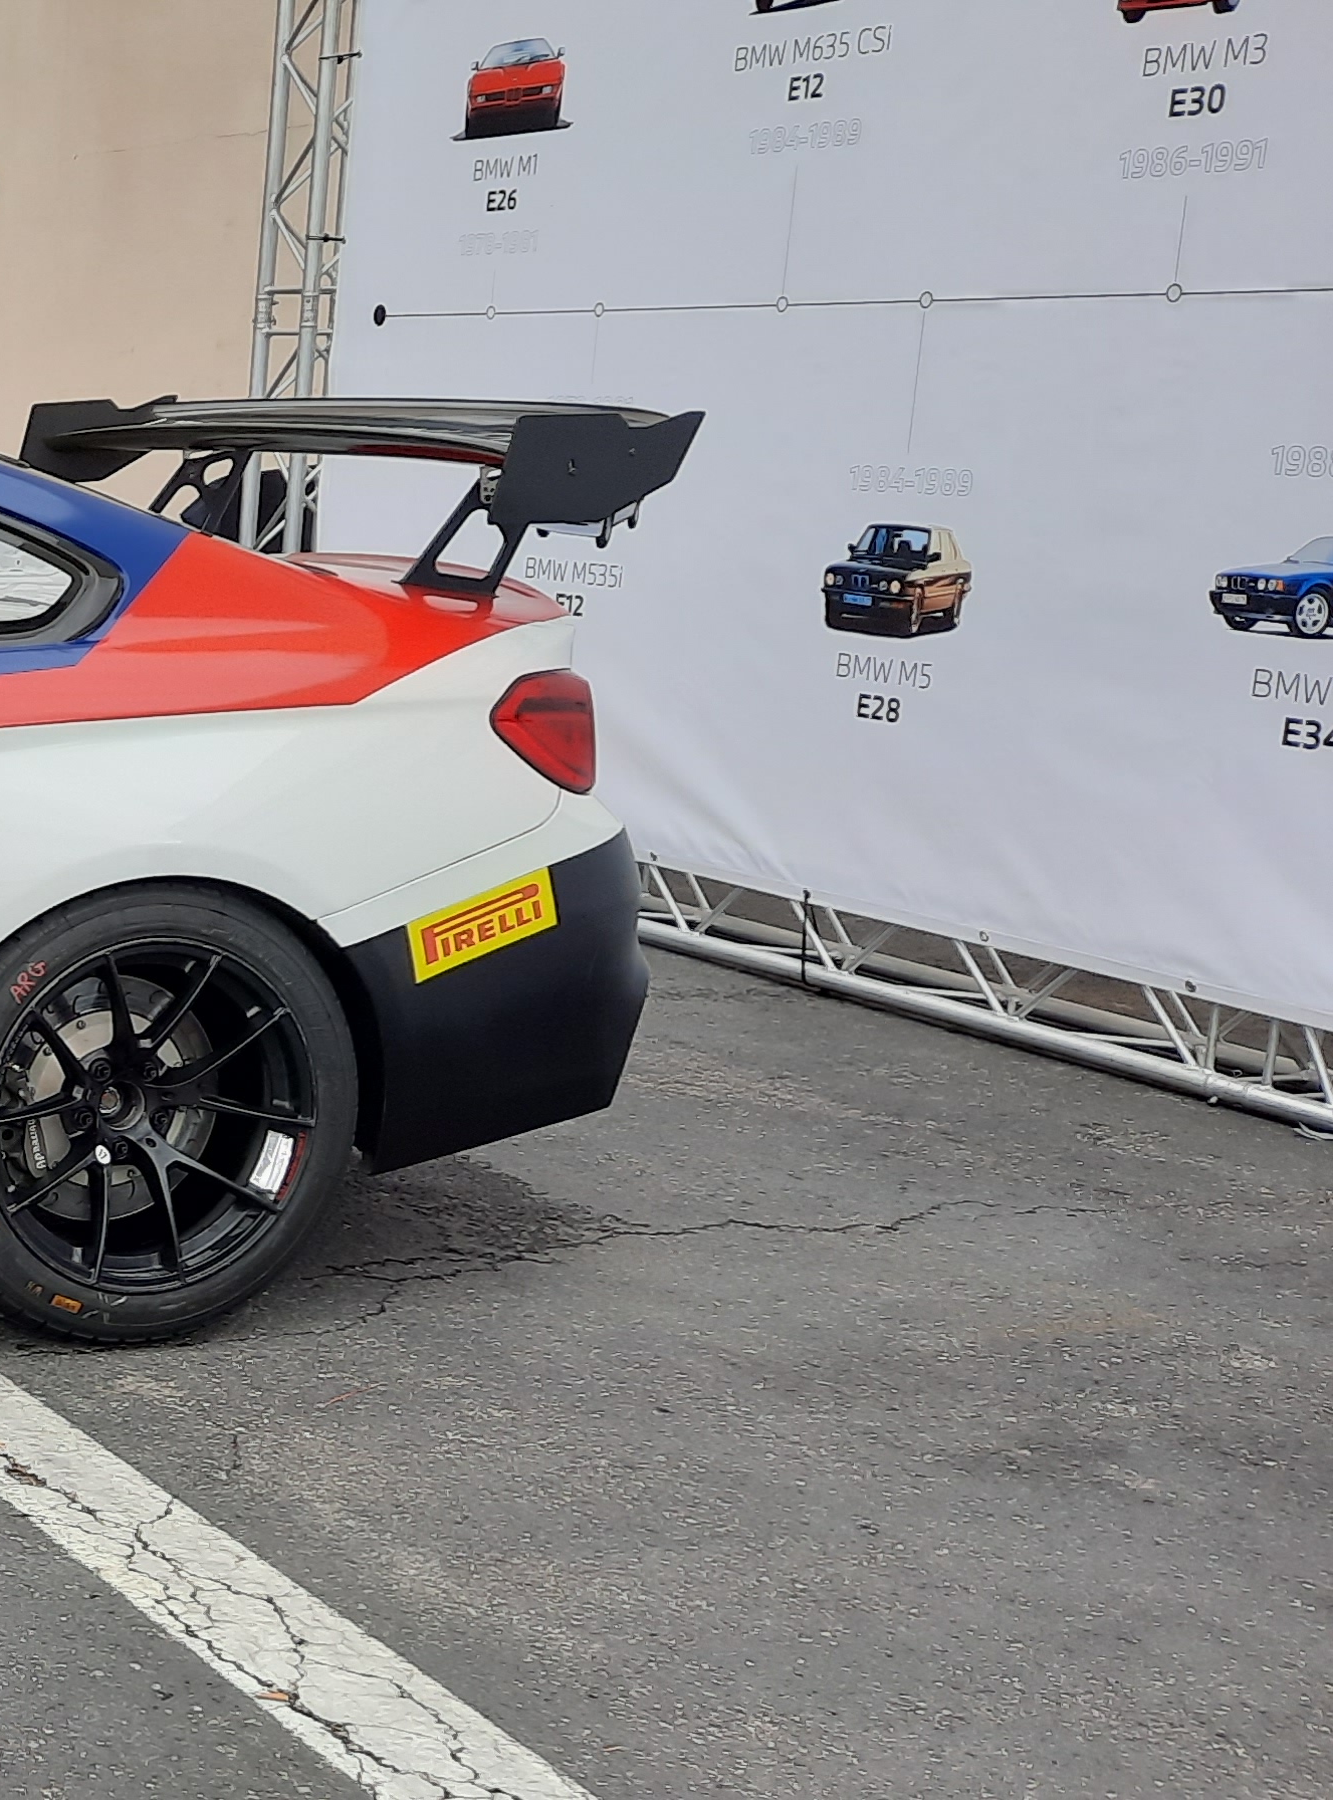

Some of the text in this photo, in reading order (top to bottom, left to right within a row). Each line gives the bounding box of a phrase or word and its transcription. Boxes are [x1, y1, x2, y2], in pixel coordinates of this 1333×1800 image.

[734, 39, 787, 72] BMW
[792, 31, 851, 64] M635
[1142, 33, 1268, 77] BMW M3
[787, 73, 825, 101] E12
[1168, 83, 1226, 118] E30
[473, 153, 538, 182] BMW M1
[1119, 137, 1269, 180] 1986-1991
[486, 188, 517, 212] E26
[1271, 444, 1333, 478] 198
[849, 464, 973, 497] 1984-1989
[525, 557, 623, 588] BMW M535i
[836, 652, 933, 690] BMW M5
[1251, 667, 1333, 706] BMW
[856, 692, 901, 723] E28
[421, 883, 543, 965] PIRELLI
